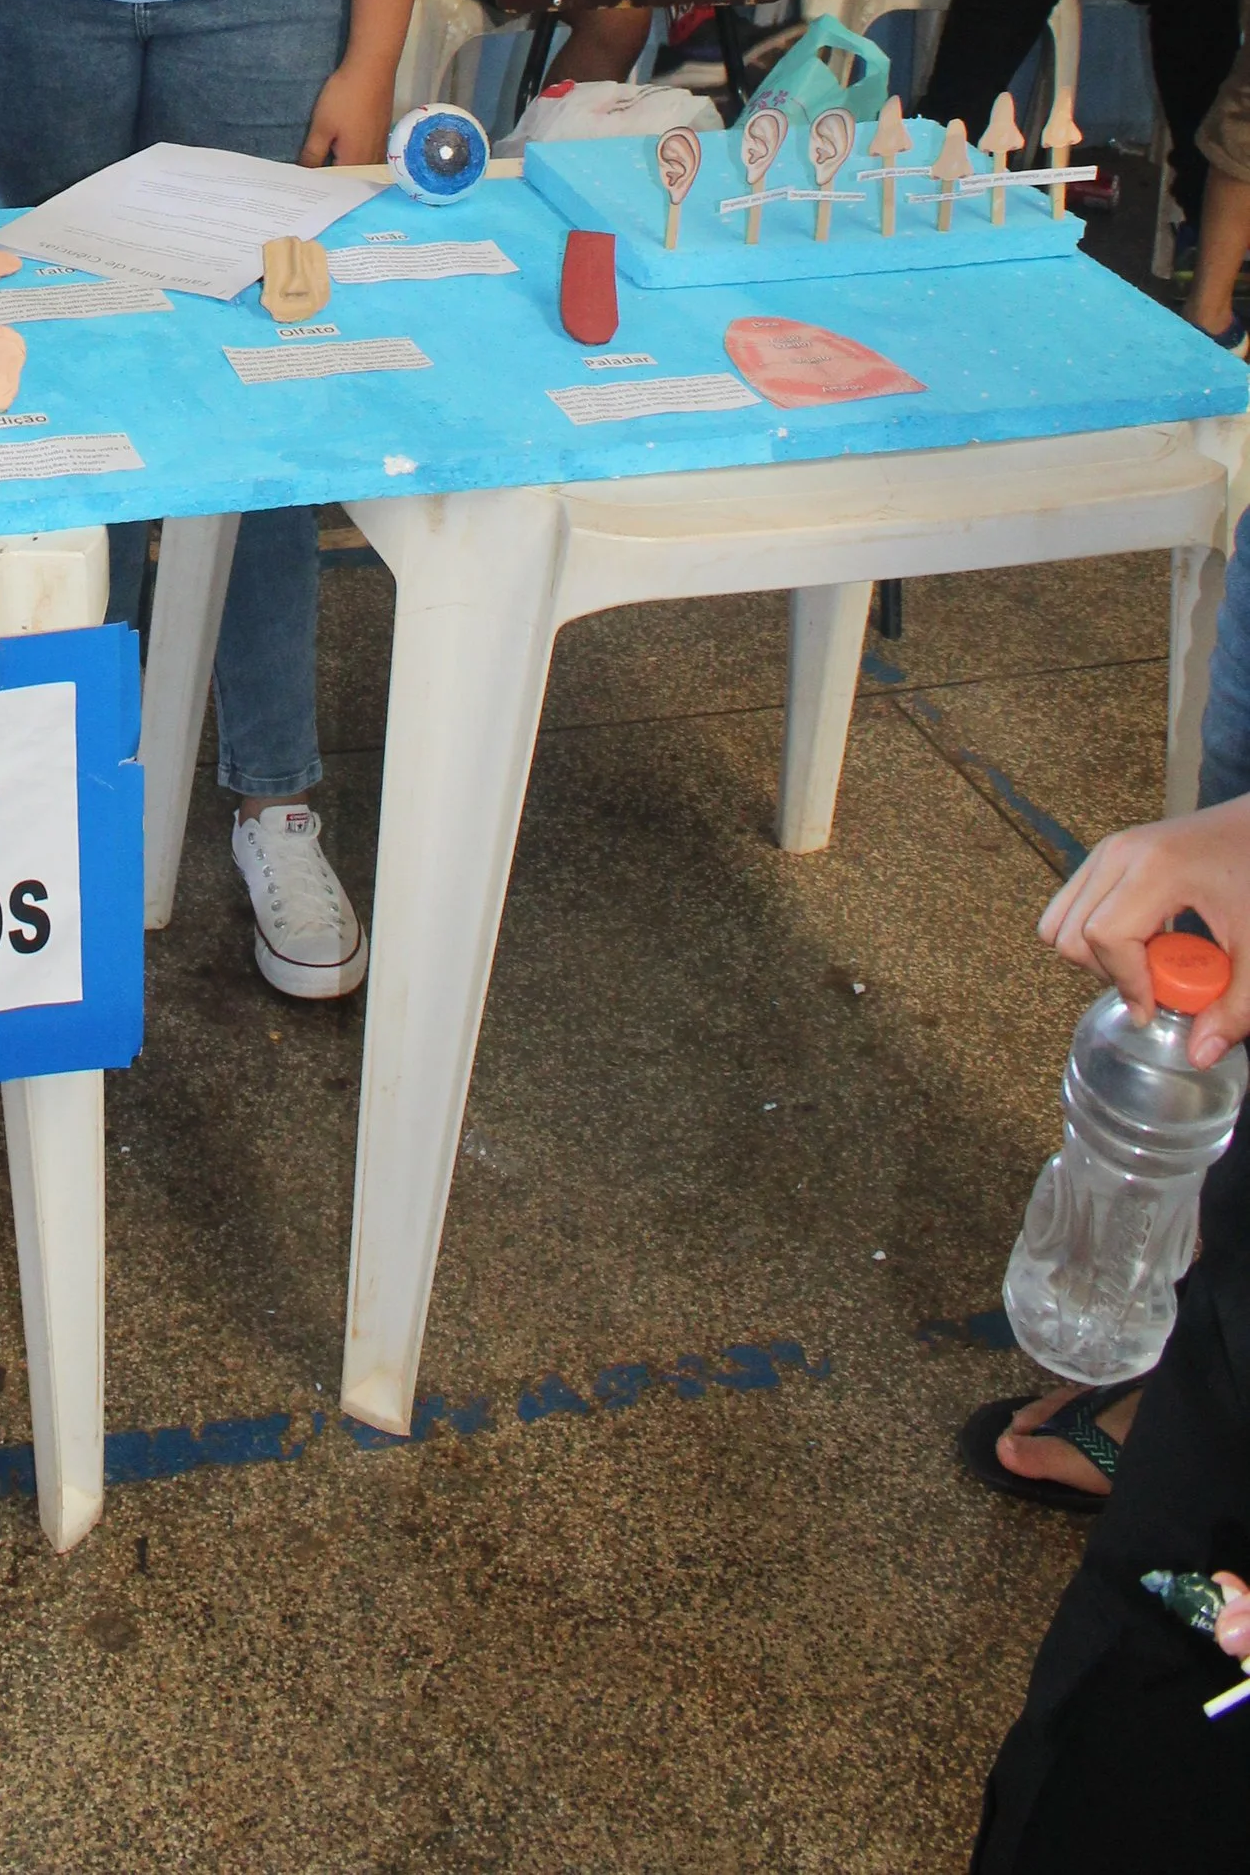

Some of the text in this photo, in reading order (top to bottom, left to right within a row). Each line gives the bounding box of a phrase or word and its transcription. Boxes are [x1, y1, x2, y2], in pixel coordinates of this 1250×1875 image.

[37, 266, 76, 276] Tato
[104, 260, 127, 272] de
[279, 325, 335, 337] Olfato
[584, 355, 649, 367] Paladar
